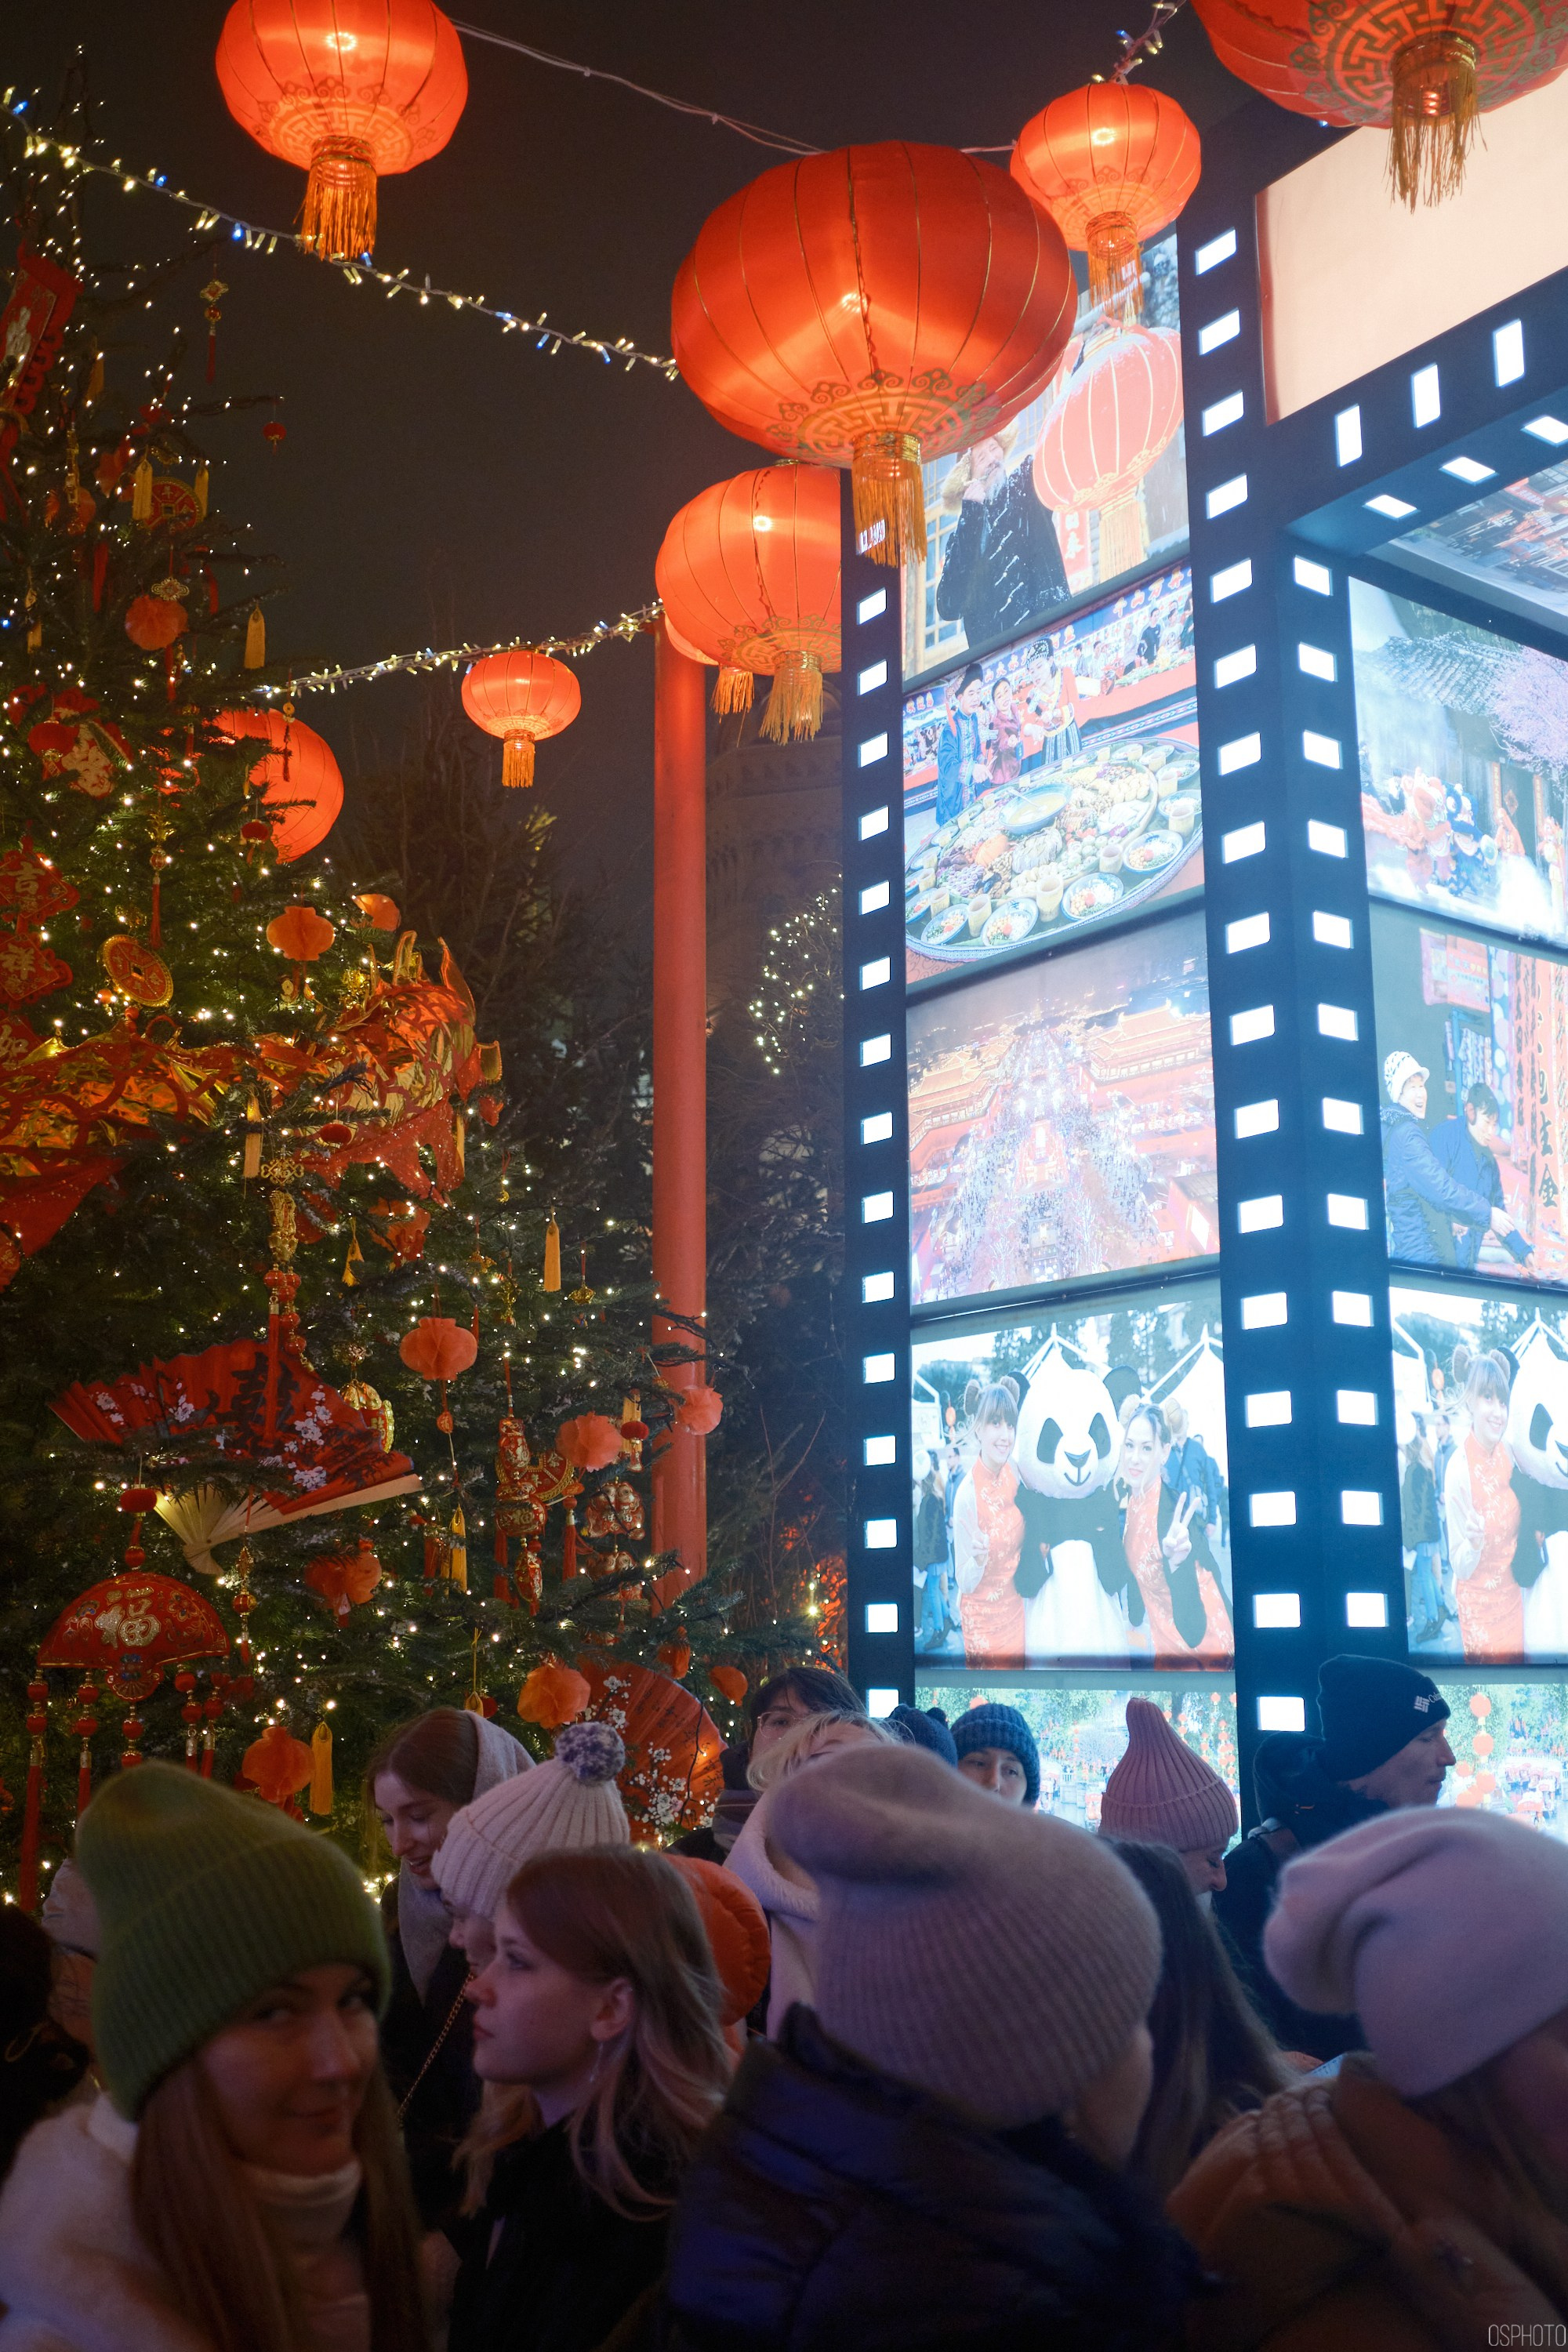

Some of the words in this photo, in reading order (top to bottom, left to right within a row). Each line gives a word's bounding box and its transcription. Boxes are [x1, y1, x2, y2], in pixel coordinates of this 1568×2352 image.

[6, 861, 45, 895] 吉
[1, 942, 36, 981] 祥
[0, 1024, 29, 1058] 如
[94, 1585, 162, 1650] 福
